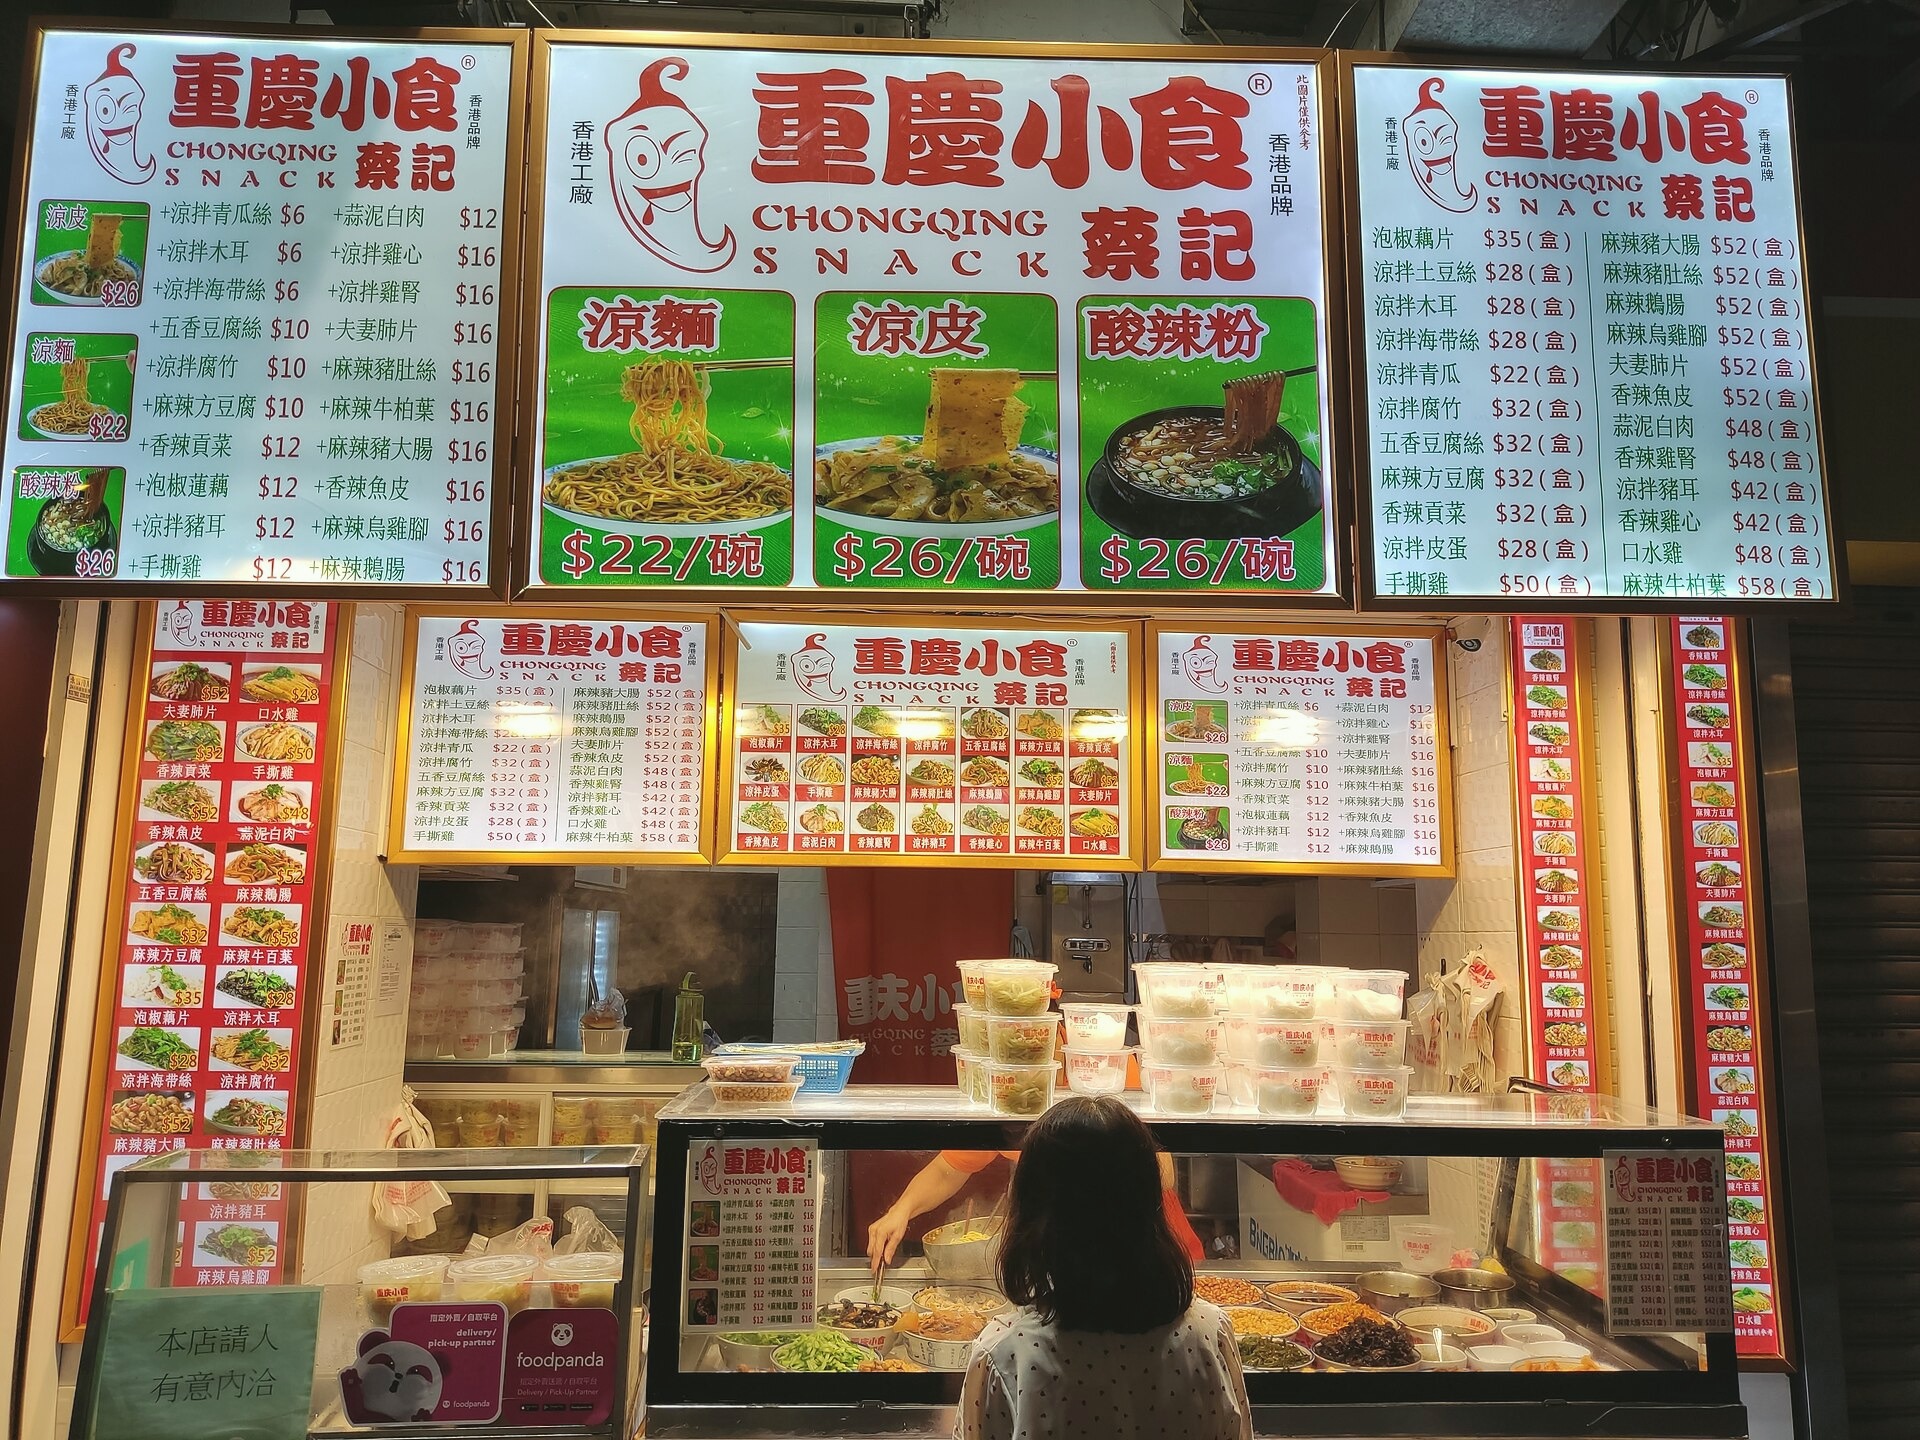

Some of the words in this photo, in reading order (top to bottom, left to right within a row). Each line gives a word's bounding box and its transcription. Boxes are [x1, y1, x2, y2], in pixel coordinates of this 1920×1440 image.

[169, 52, 461, 133] 重慶小食
[60, 84, 79, 140] 香港工廠
[466, 94, 483, 149] 香港品牌
[750, 69, 1253, 191] 重慶小食
[1479, 85, 1751, 165] 重慶小食
[166, 142, 337, 164] CHONGQING
[1385, 117, 1400, 170] 香港工廠
[355, 142, 455, 192] 蔡記
[570, 120, 594, 205] 香港工廠
[1758, 129, 1774, 182] 香港品牌
[165, 169, 335, 189] SNACK
[1269, 133, 1294, 218] 香港品牌
[1485, 170, 1643, 193] CHONGQING
[1487, 197, 1646, 217] SNACK
[1661, 174, 1756, 223] 蔡記
[46, 204, 88, 231] 涼皮
[280, 205, 305, 225] $6
[460, 207, 497, 229] $12
[753, 204, 1048, 237] CHONGQING
[1082, 207, 1255, 282] 蔡記
[1372, 226, 1454, 250] 泡椒藕片
[1601, 231, 1700, 256] 麻辣豬大腸
[277, 243, 302, 263] $6
[457, 246, 496, 267] $16
[754, 248, 1048, 277] SNACK
[1373, 260, 1477, 283] 涼拌土豆絲
[1603, 262, 1703, 286] 麻辣豬肚絲
[101, 280, 138, 307] $26
[274, 281, 299, 301] $6
[455, 284, 494, 306] $16
[1375, 294, 1457, 317] 涼拌木耳
[1605, 292, 1684, 316] 麻辣鵝腸
[270, 319, 310, 340] $10
[453, 323, 492, 344] $16
[582, 299, 719, 352] 涼麵
[851, 302, 986, 356] 涼皮
[1084, 306, 1265, 360] 酸辣粉
[32, 338, 75, 363] 涼麵
[267, 358, 306, 379] $10
[451, 361, 491, 383] $16
[1376, 363, 1460, 385] 涼拌青瓜
[1609, 352, 1689, 376] 夫妻肺片
[1611, 384, 1693, 407] 香辣魚皮
[264, 397, 304, 419] $10
[449, 401, 489, 423] $16
[1378, 397, 1461, 420] 涼拌腐竹
[89, 416, 126, 439] $22
[1613, 415, 1694, 438] 蒜泥白肉
[261, 436, 301, 458] $12
[448, 440, 487, 462] $16
[1380, 431, 1484, 455] 五香豆腐絲
[20, 473, 81, 499] 酸辣粉
[258, 477, 298, 498] $12
[1381, 467, 1484, 491] 麻辣方豆腐
[1616, 477, 1699, 501] 涼拌豬耳
[446, 480, 485, 502] $16
[1382, 501, 1466, 525] 香辣貢菜
[1618, 509, 1701, 533] 香辣雞心
[255, 517, 295, 539] $12
[443, 520, 483, 542] $16
[562, 532, 765, 580] $22/碗
[834, 535, 1031, 582] $26/碗
[1383, 536, 1467, 560] 涼拌皮蛋
[1622, 541, 1683, 564] 口水雞
[76, 550, 114, 576] $26
[252, 558, 292, 580] $12
[441, 559, 481, 583] $16
[1101, 537, 1296, 583] $26/碗
[1384, 571, 1449, 596] 手撕雞
[201, 601, 310, 628] 重慶小食
[200, 640, 263, 648] SNACK
[201, 631, 264, 639] CHONGQING
[271, 632, 309, 649] 蔡記
[500, 623, 683, 659] 重慶小食
[500, 660, 606, 671] CHONGQING
[853, 637, 1068, 677] 重慶小食
[1232, 639, 1406, 673] 重慶小食
[619, 662, 681, 683] 蔡記
[1234, 675, 1334, 686] CHONGQING
[854, 680, 978, 692] CHONGQING
[994, 682, 1068, 706] 蔡記
[1347, 677, 1406, 698] 蔡記
[854, 694, 979, 704] SNACK
[163, 705, 216, 719] 夫妻肺片
[1204, 733, 1226, 743] $26
[134, 1010, 190, 1025] 泡椒藕片
[224, 1011, 280, 1026] 涼拌木耳
[170, 1054, 197, 1069] $28
[262, 1055, 289, 1070] $32
[220, 1073, 276, 1089] 涼拌腐竹
[724, 1147, 806, 1174] 重慶小食
[158, 1323, 279, 1358] 本店請人
[428, 1339, 460, 1349] pick-up
[463, 1339, 496, 1347] partner
[457, 1329, 497, 1338] delivery/
[517, 1352, 604, 1371] foodpanda
[453, 1400, 490, 1408] foodpanda
[517, 1388, 544, 1397] Delivery
[549, 1388, 574, 1396] Pick-Up
